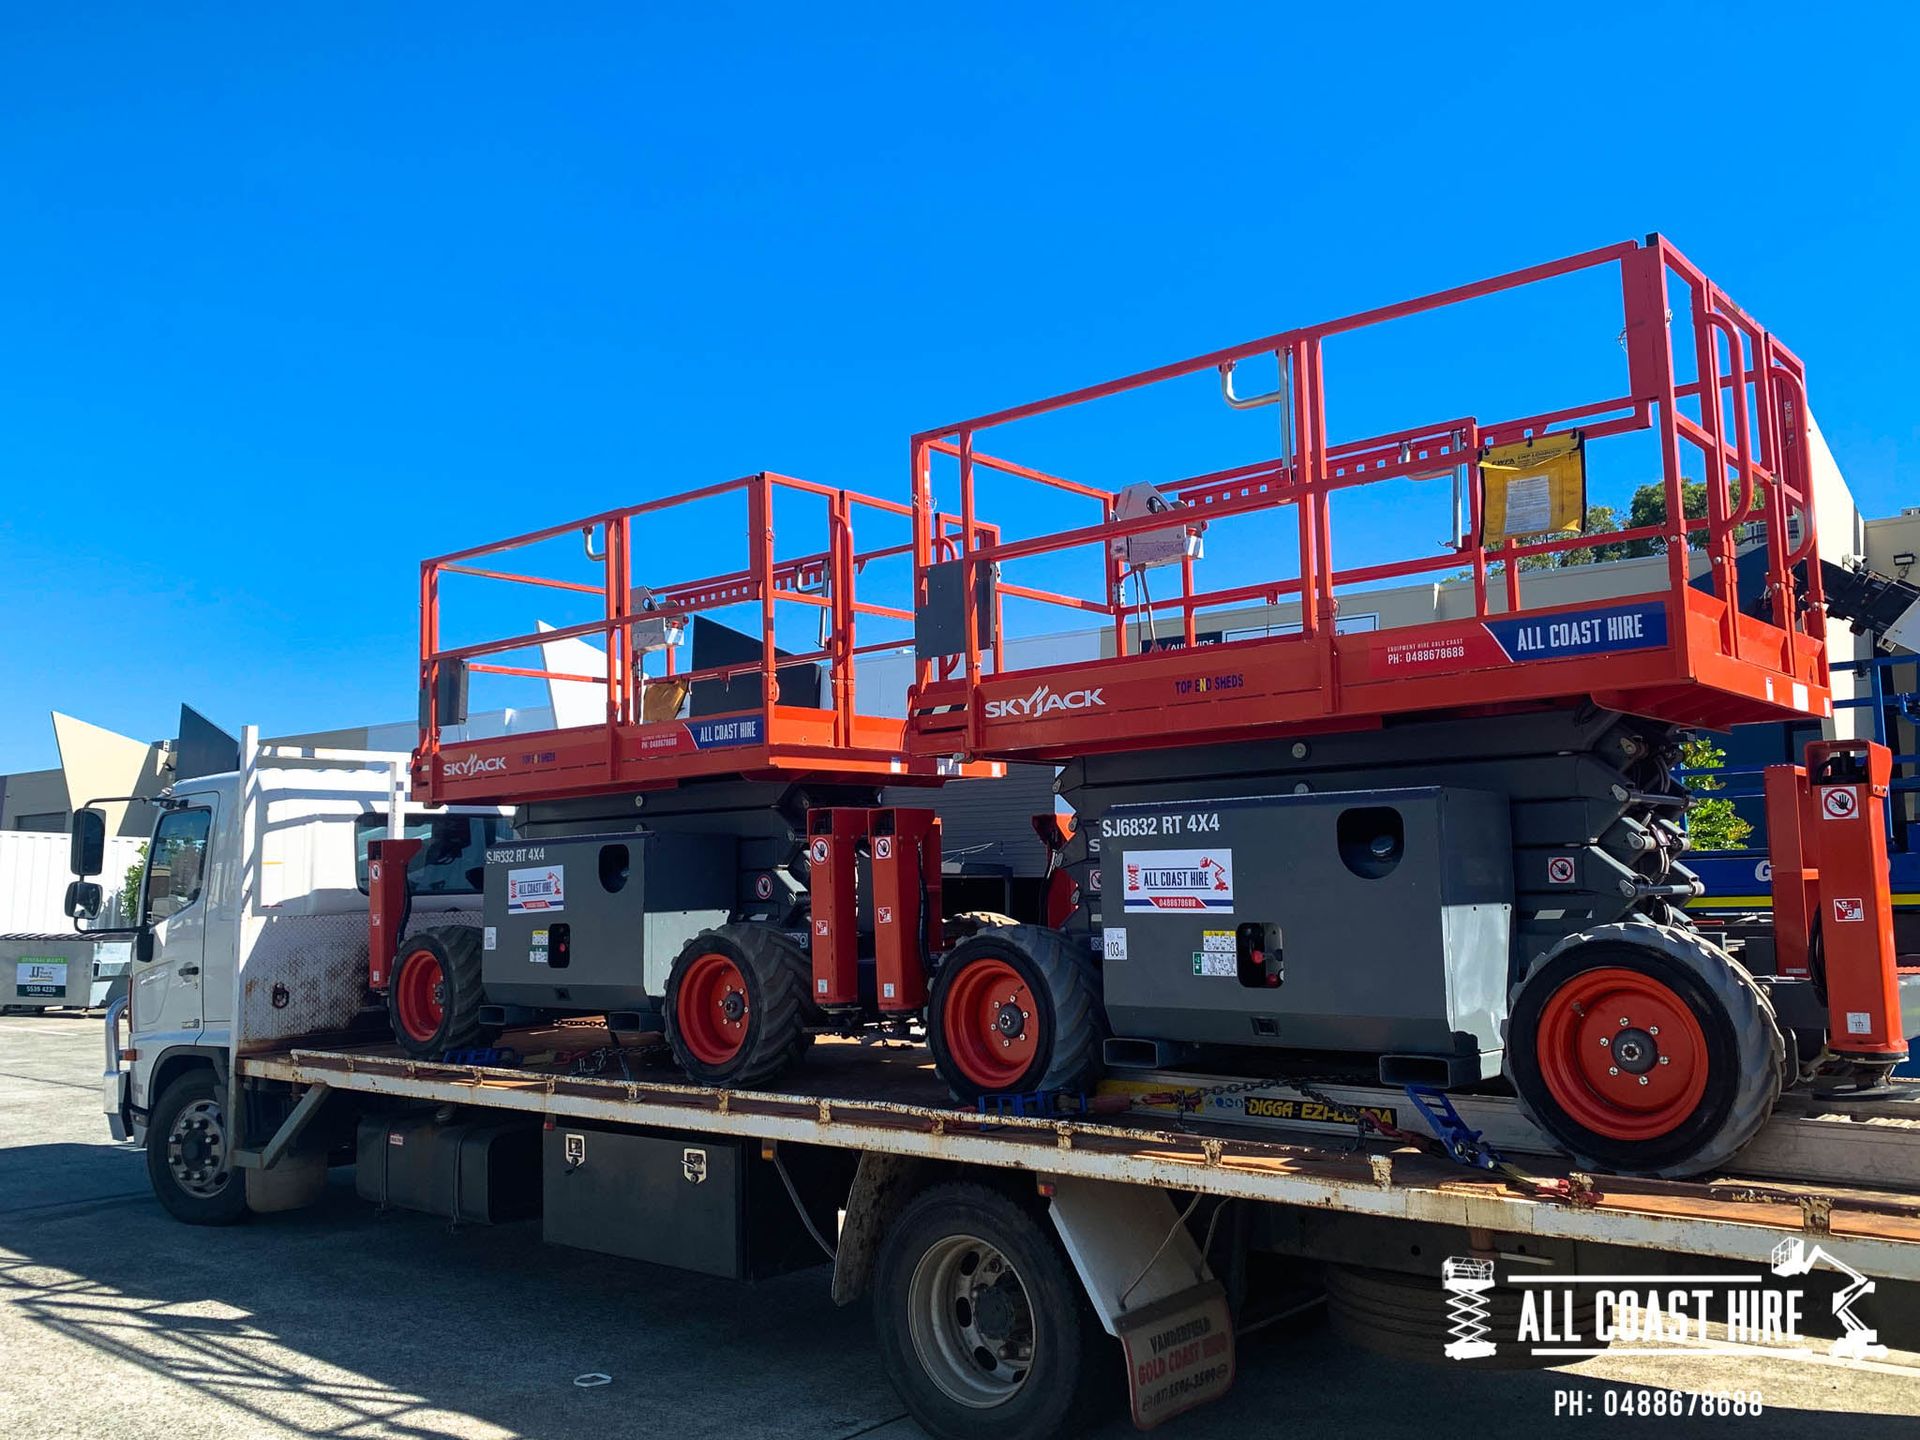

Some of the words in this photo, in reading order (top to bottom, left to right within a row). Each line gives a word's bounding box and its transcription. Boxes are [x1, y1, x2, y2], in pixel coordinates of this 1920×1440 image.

[1446, 638, 1463, 646] COAST
[1517, 626, 1545, 651] ALL
[1549, 619, 1602, 648] COAST
[1607, 614, 1644, 641] HIRE
[1388, 653, 1402, 665] PH:
[1405, 646, 1464, 663] 0488678688
[1175, 680, 1192, 695] TOP
[1195, 678, 1212, 693] END
[1214, 674, 1244, 690] SHEDS
[985, 685, 1106, 718] SKYJACK
[700, 727, 713, 743] ALL
[714, 723, 738, 741] COAST
[739, 721, 756, 738] HIRE
[443, 754, 507, 776] SKYJACK
[1102, 817, 1158, 838] SJ6832
[1162, 815, 1183, 835] RT
[1187, 813, 1221, 833] 4X4
[516, 848, 527, 863] RT
[528, 847, 545, 861] 4X4
[1144, 872, 1159, 887] ALL
[1160, 872, 1188, 887] COAST
[1190, 871, 1209, 886] HIRE
[1106, 941, 1120, 957] 103
[1249, 1098, 1293, 1118] DIGGA
[1138, 1357, 1165, 1386] GOLD
[1168, 1342, 1200, 1372] COAST
